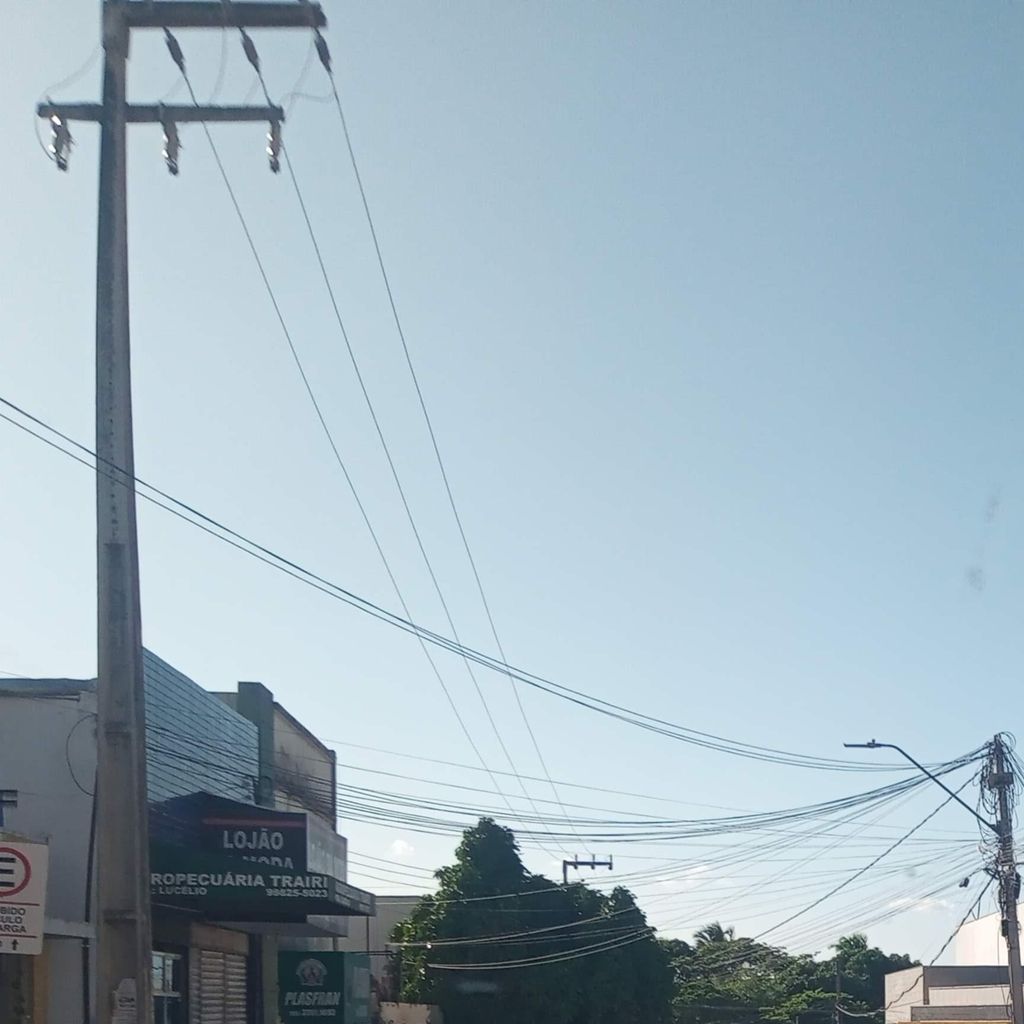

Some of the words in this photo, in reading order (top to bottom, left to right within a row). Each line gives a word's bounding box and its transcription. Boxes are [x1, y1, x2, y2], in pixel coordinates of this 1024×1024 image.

[223, 828, 284, 850] LOJÃO
[151, 872, 266, 887] ROPECUÁRIA
[269, 875, 328, 889] TRAIRI
